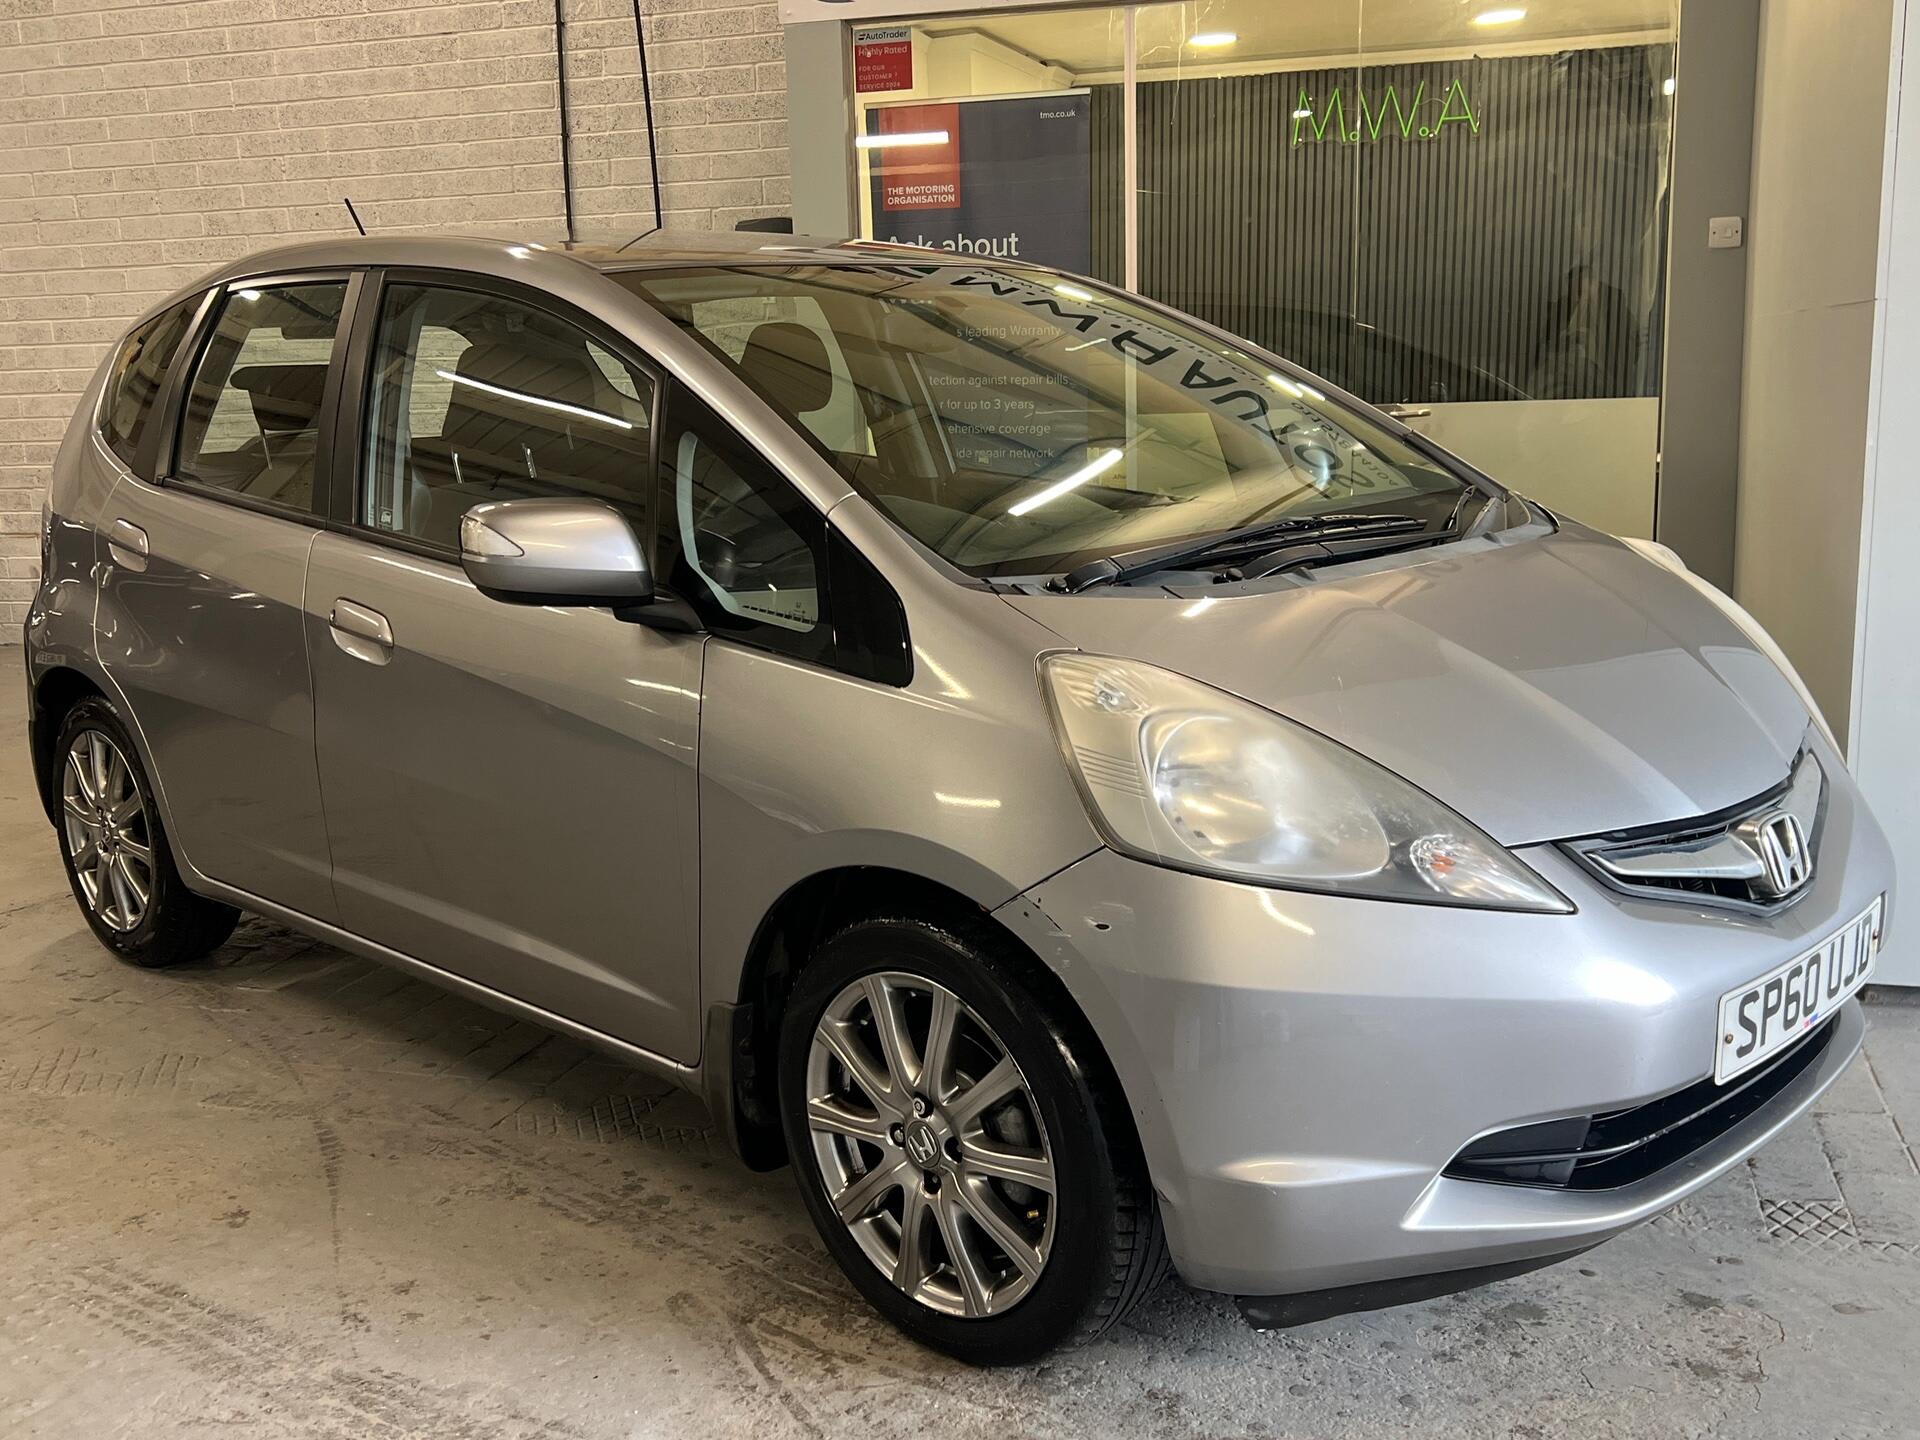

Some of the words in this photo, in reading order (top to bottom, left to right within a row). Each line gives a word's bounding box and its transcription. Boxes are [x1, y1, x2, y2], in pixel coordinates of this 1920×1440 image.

[865, 30, 907, 40] AutoTrader
[884, 45, 908, 54] Rated
[1039, 109, 1076, 119] tmo.co.uk
[887, 186, 904, 196] THE
[905, 184, 955, 194] MOTORING
[887, 194, 955, 205] ORGANISATION
[942, 232, 1019, 257] about
[965, 326, 1006, 338] leading
[1009, 325, 1061, 337] Warranty
[929, 375, 966, 386] tection
[968, 375, 1007, 388] against
[1010, 374, 1043, 387] repair
[947, 398, 961, 409] for
[964, 400, 977, 411] up
[980, 399, 991, 409] to
[993, 398, 1001, 409] 3
[1004, 400, 1035, 411] years
[948, 424, 995, 434] ehensive
[998, 424, 1051, 436] coverage
[975, 448, 1006, 459] repair
[1009, 447, 1055, 458] network
[1736, 951, 1821, 1058] SP60
[1826, 912, 1873, 999] UJD
